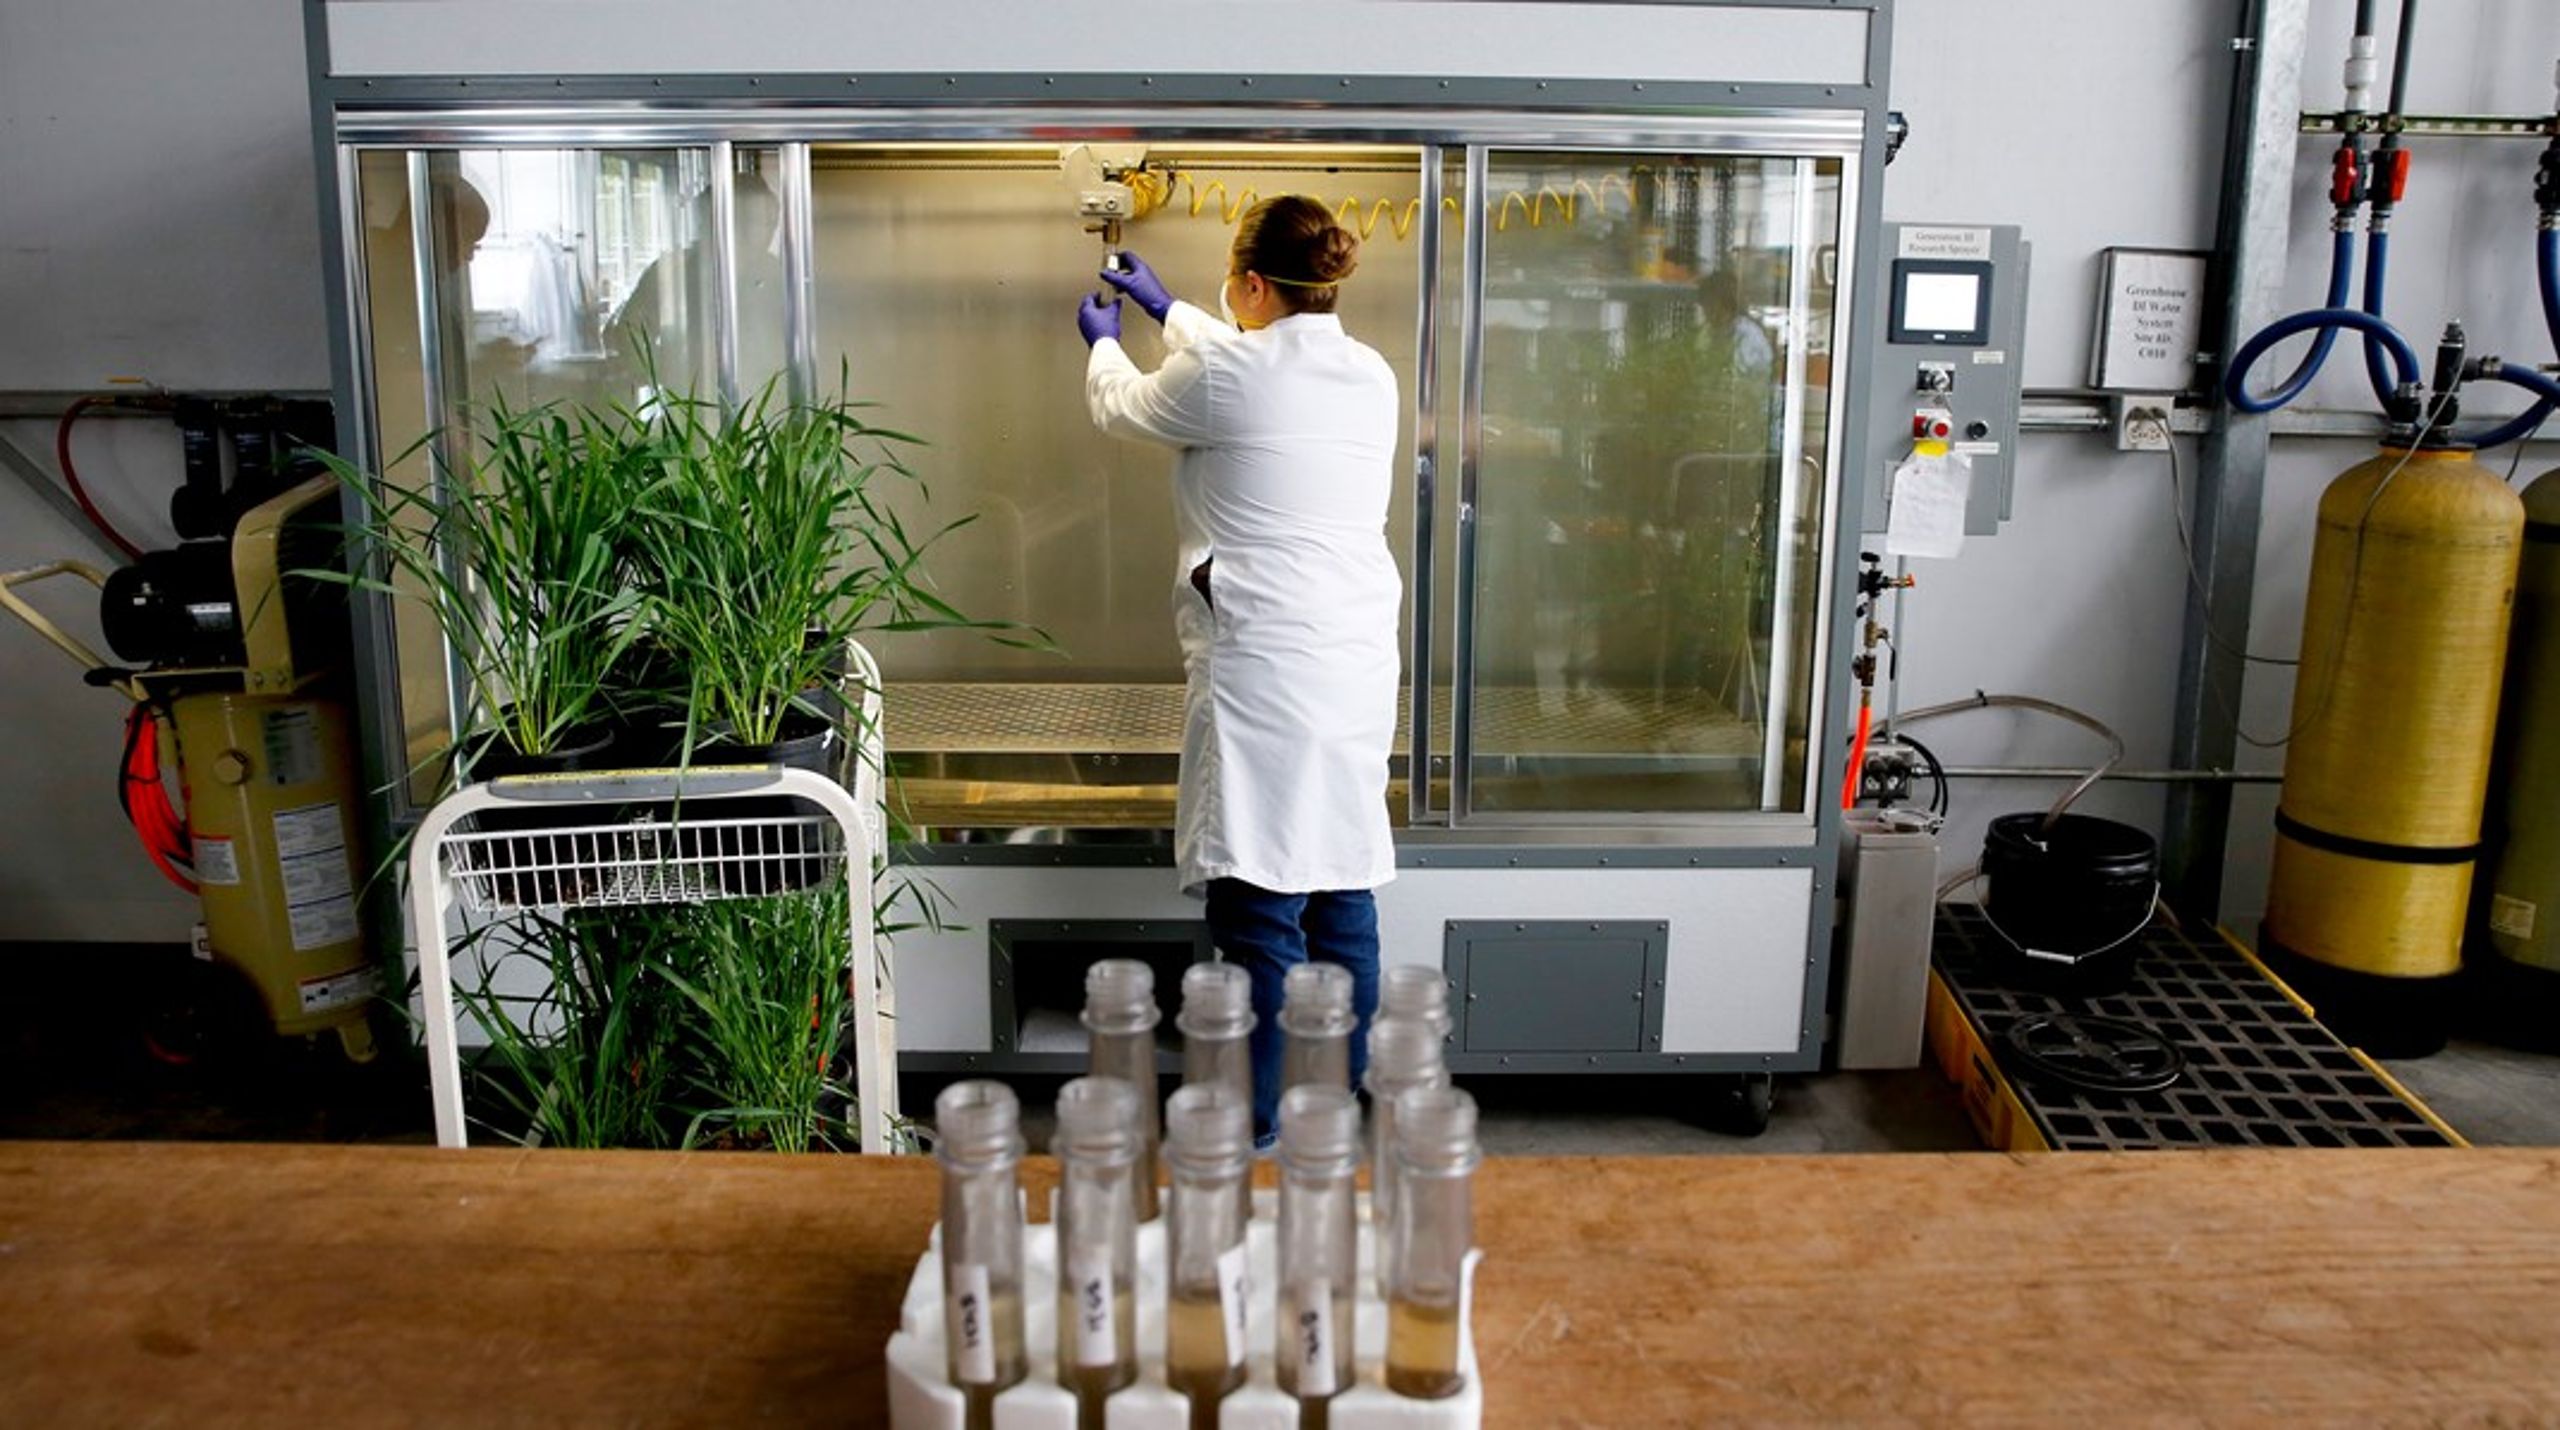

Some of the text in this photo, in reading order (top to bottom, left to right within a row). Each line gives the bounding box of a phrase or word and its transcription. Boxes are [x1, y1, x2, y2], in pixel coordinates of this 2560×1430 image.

[2126, 285, 2187, 298] Greenhouse
[2149, 301, 2182, 313] Water
[2138, 318, 2174, 330] System
